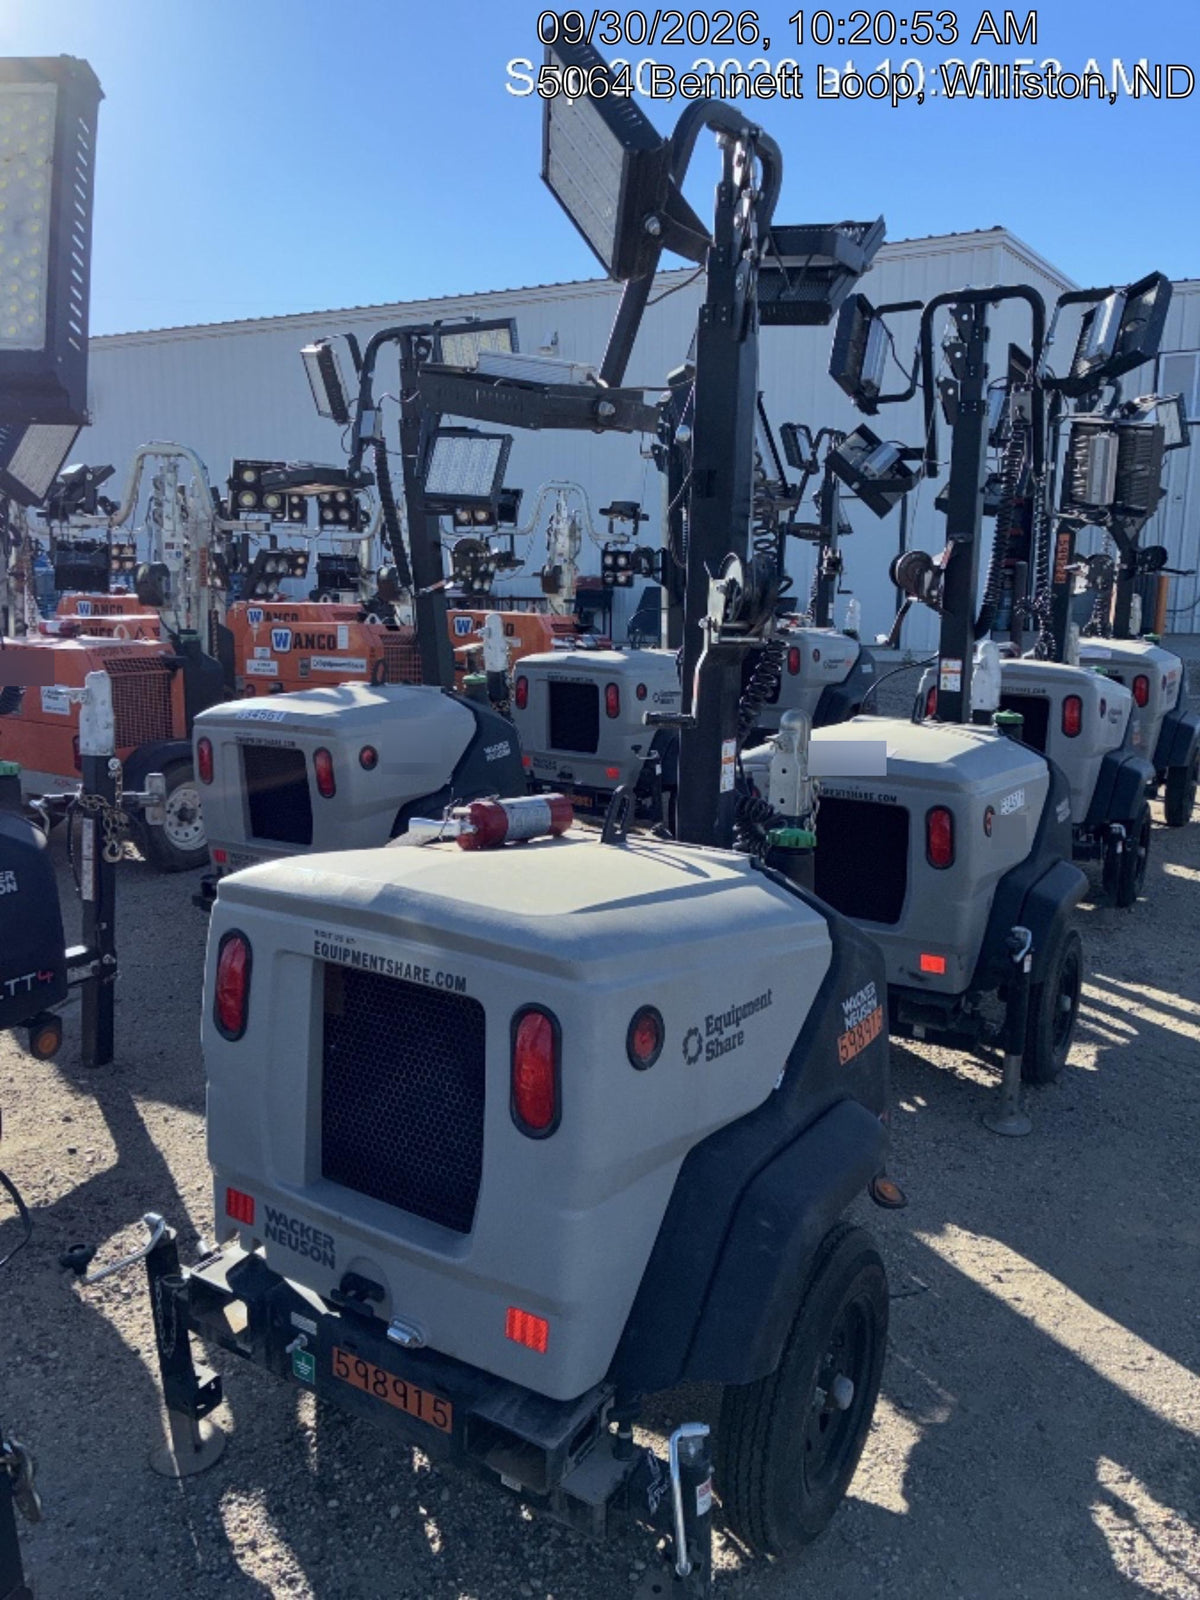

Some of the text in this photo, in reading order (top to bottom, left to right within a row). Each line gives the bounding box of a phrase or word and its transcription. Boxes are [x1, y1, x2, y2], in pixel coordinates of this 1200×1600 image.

[273, 632, 337, 650] WANCO
[313, 940, 467, 993] EQUIPMENTSHARE.COM
[704, 988, 773, 1036] Equipment
[842, 981, 876, 1014] WACKER
[705, 1030, 744, 1062] Share
[264, 1204, 335, 1253] WACKER
[264, 1222, 335, 1270] NEUSON
[335, 1350, 448, 1429] 598915
